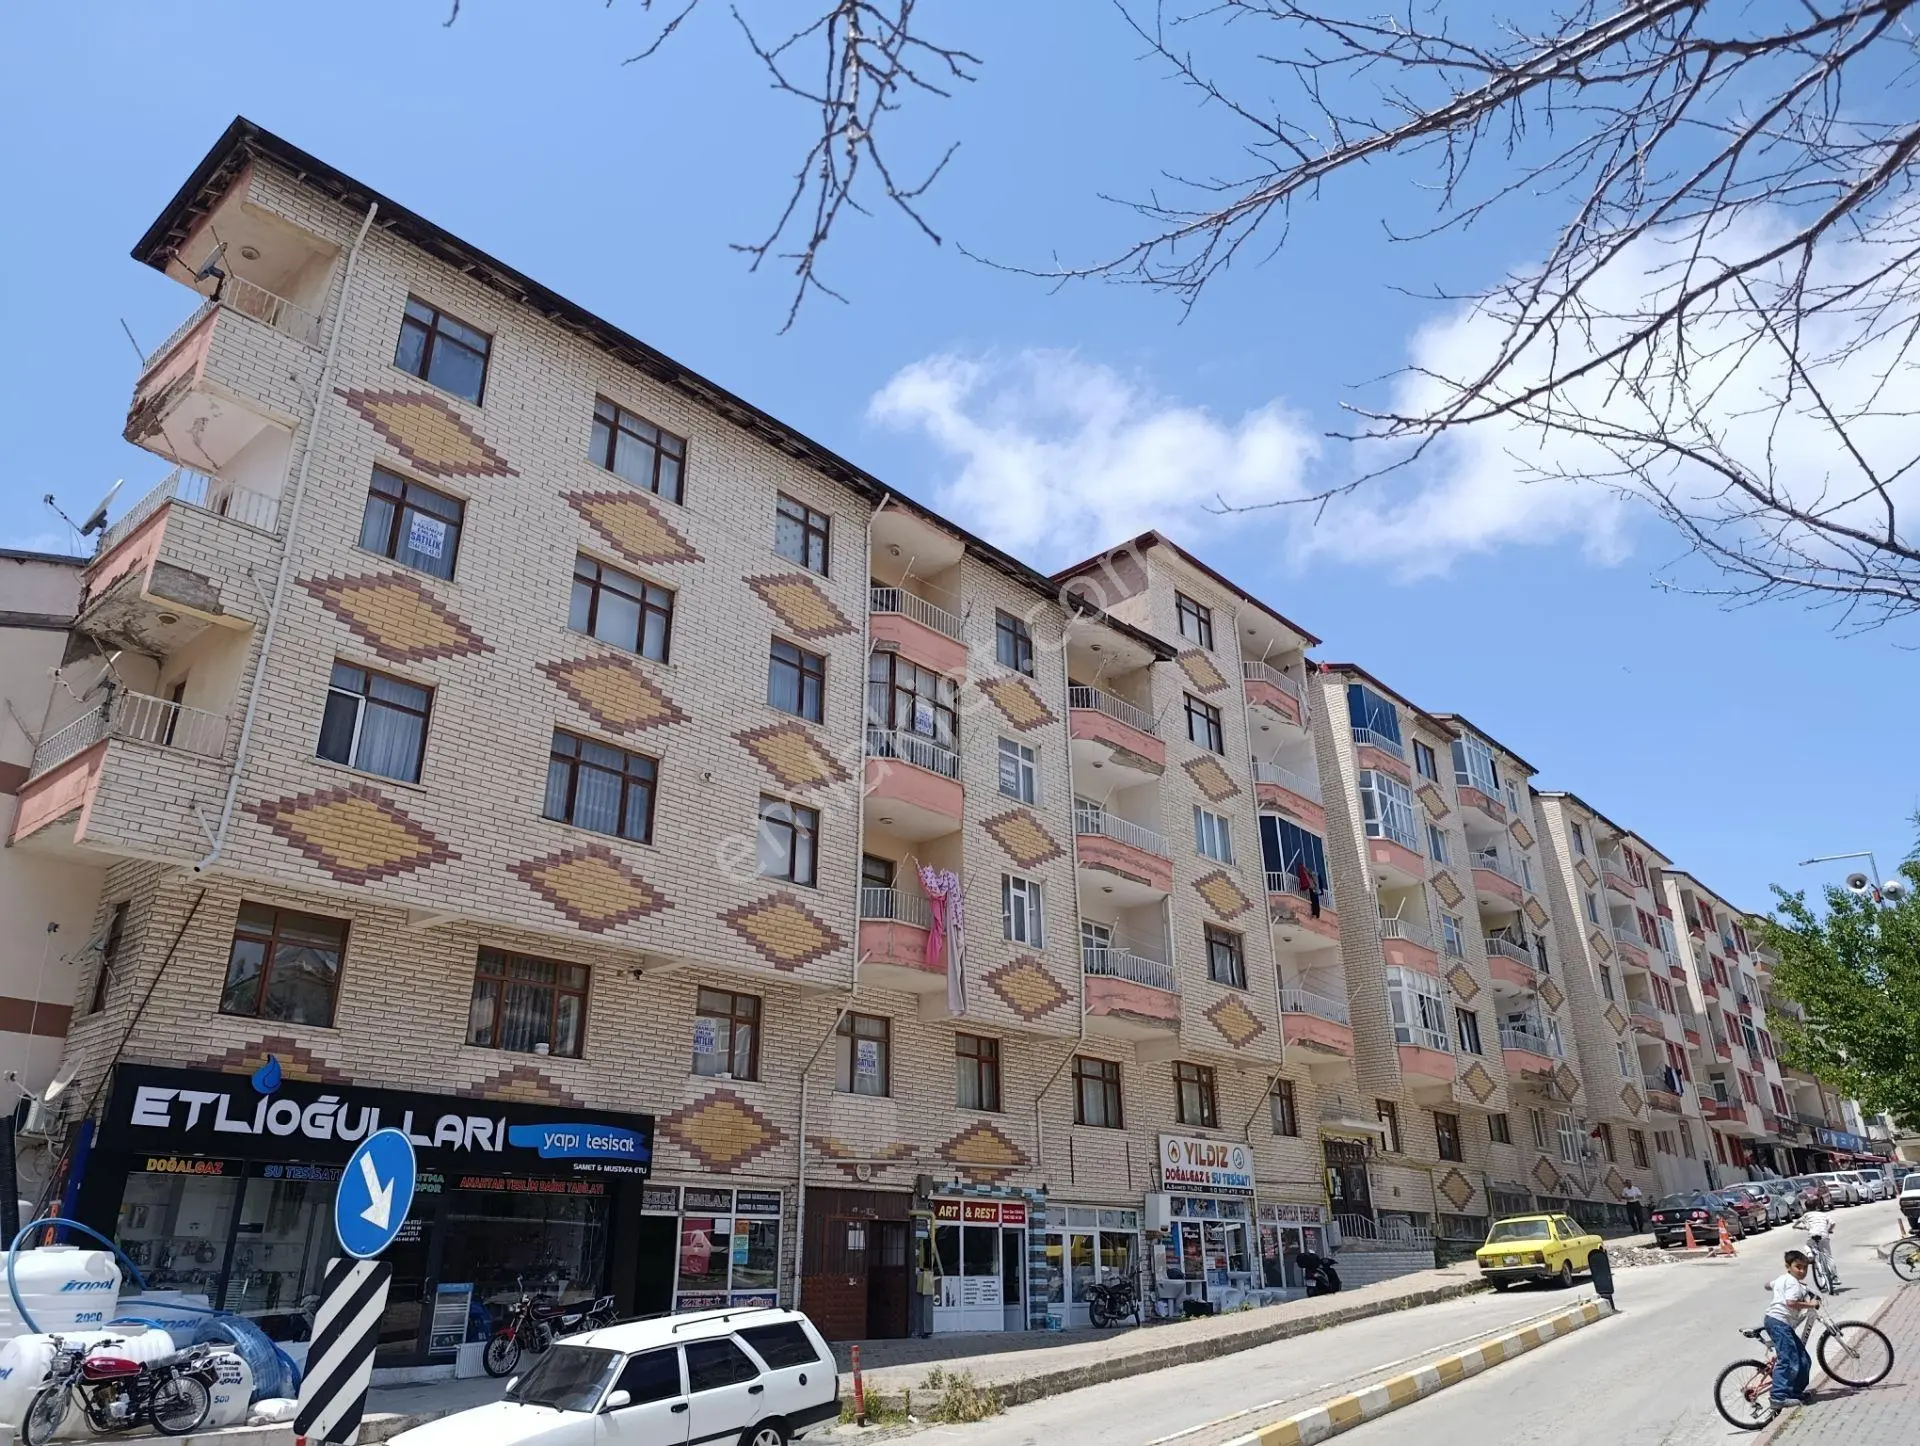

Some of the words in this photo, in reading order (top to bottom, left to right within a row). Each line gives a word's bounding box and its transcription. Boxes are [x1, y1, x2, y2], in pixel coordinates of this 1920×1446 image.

[410, 531, 441, 550] SATILIK
[543, 1132, 579, 1151] yapı
[586, 1133, 635, 1152] tesisat
[1184, 1141, 1228, 1168] YILDIZ
[147, 1157, 224, 1175] DOĞALGAZ
[264, 1165, 282, 1178] SU
[573, 1163, 596, 1172] SAMET
[604, 1165, 633, 1174] MUSTAFA
[1165, 1166, 1204, 1183] DOĞALGAZ
[1211, 1172, 1221, 1184] SU
[1222, 1172, 1251, 1186] TESİSATI
[685, 1193, 731, 1208] EMLAK
[939, 1205, 958, 1217] ART
[965, 1207, 972, 1218] &
[974, 1208, 997, 1220] REST
[214, 1395, 230, 1404] 500
